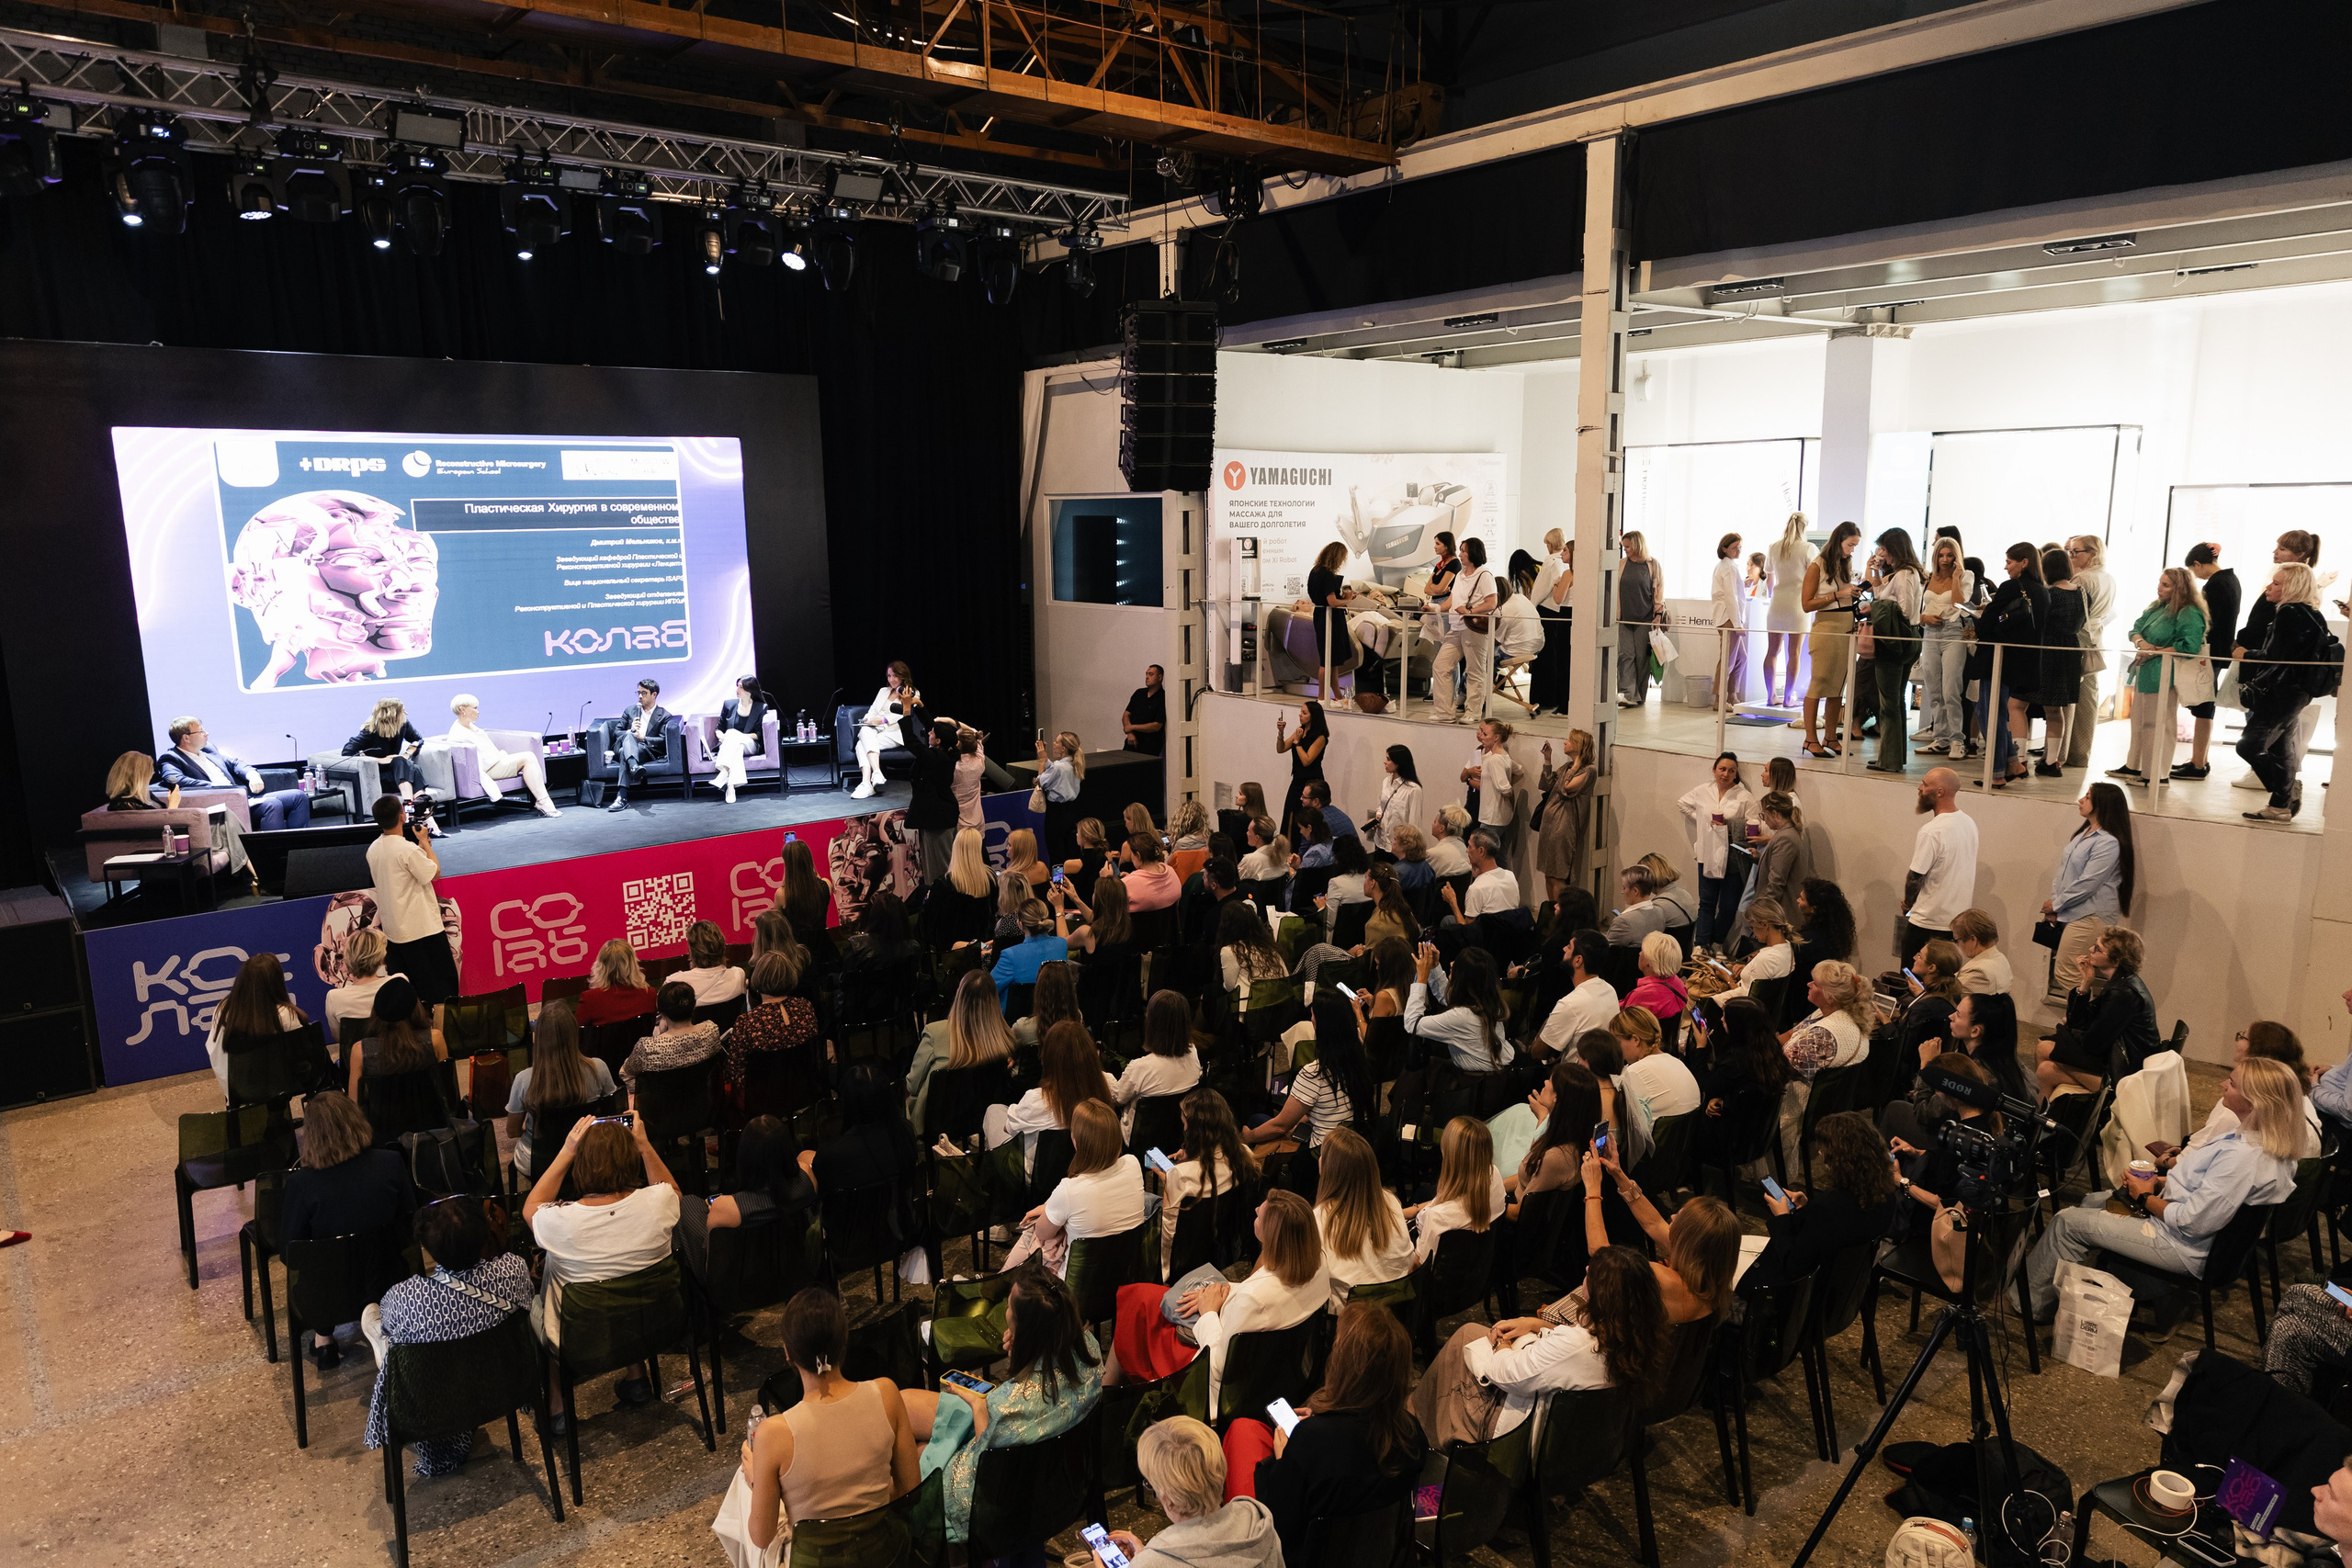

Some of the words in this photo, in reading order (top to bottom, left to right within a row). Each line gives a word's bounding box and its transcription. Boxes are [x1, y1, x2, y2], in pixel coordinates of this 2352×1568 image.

[435, 459, 494, 468] Reconstructive
[496, 460, 547, 469] Microsurgery
[436, 468, 475, 477] European
[1250, 467, 1332, 486] YAMAGUCHI
[465, 503, 544, 514] Пластическая
[548, 502, 597, 514] Хирургия
[610, 503, 679, 513] современном
[1268, 511, 1283, 519] ДЛЯ
[630, 515, 680, 525] обществе
[1261, 521, 1306, 529] ДОЛГОЛЕТИЯ
[591, 538, 624, 547] Дмитрий
[1269, 537, 1287, 546] робот
[556, 555, 598, 563] Заведующий
[599, 554, 631, 562] кафедрой
[556, 561, 621, 571] Реконструктивной
[564, 579, 582, 587] Вице
[582, 577, 629, 586] национальный
[587, 600, 635, 609] Пластической
